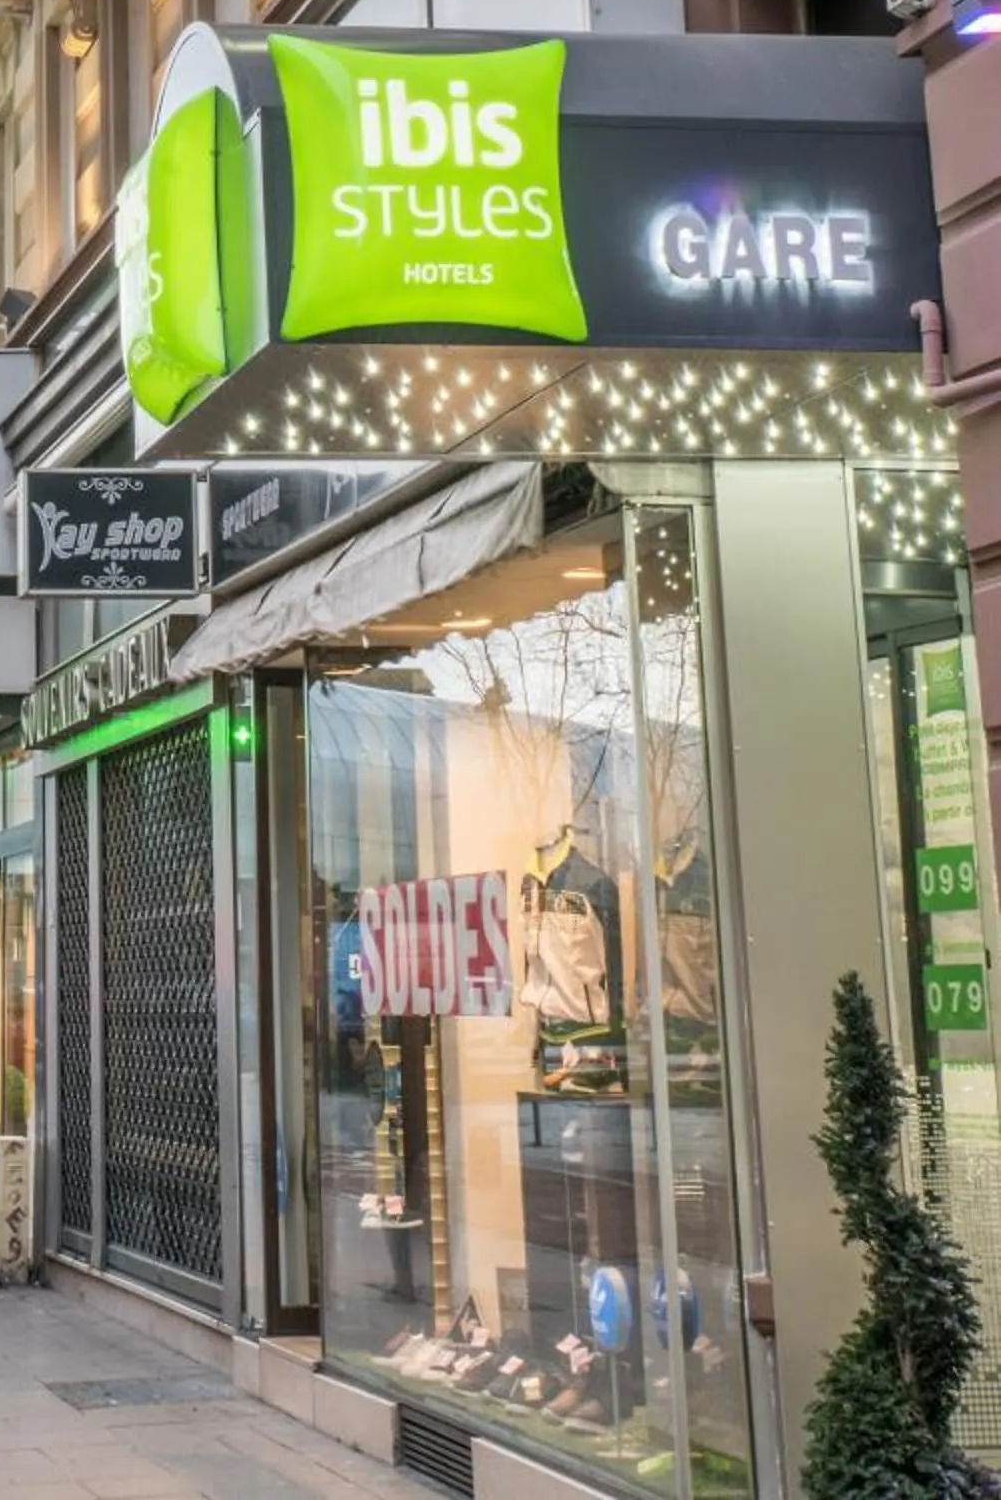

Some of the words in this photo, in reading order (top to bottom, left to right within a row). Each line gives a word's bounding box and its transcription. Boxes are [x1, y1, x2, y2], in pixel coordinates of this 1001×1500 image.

[356, 77, 524, 169] ibis
[660, 206, 873, 284] GARE
[402, 262, 495, 286] HOTELS
[103, 510, 186, 550] shop
[919, 861, 974, 897] 099
[358, 870, 514, 1017] SOLDES
[927, 979, 983, 1014] 079
